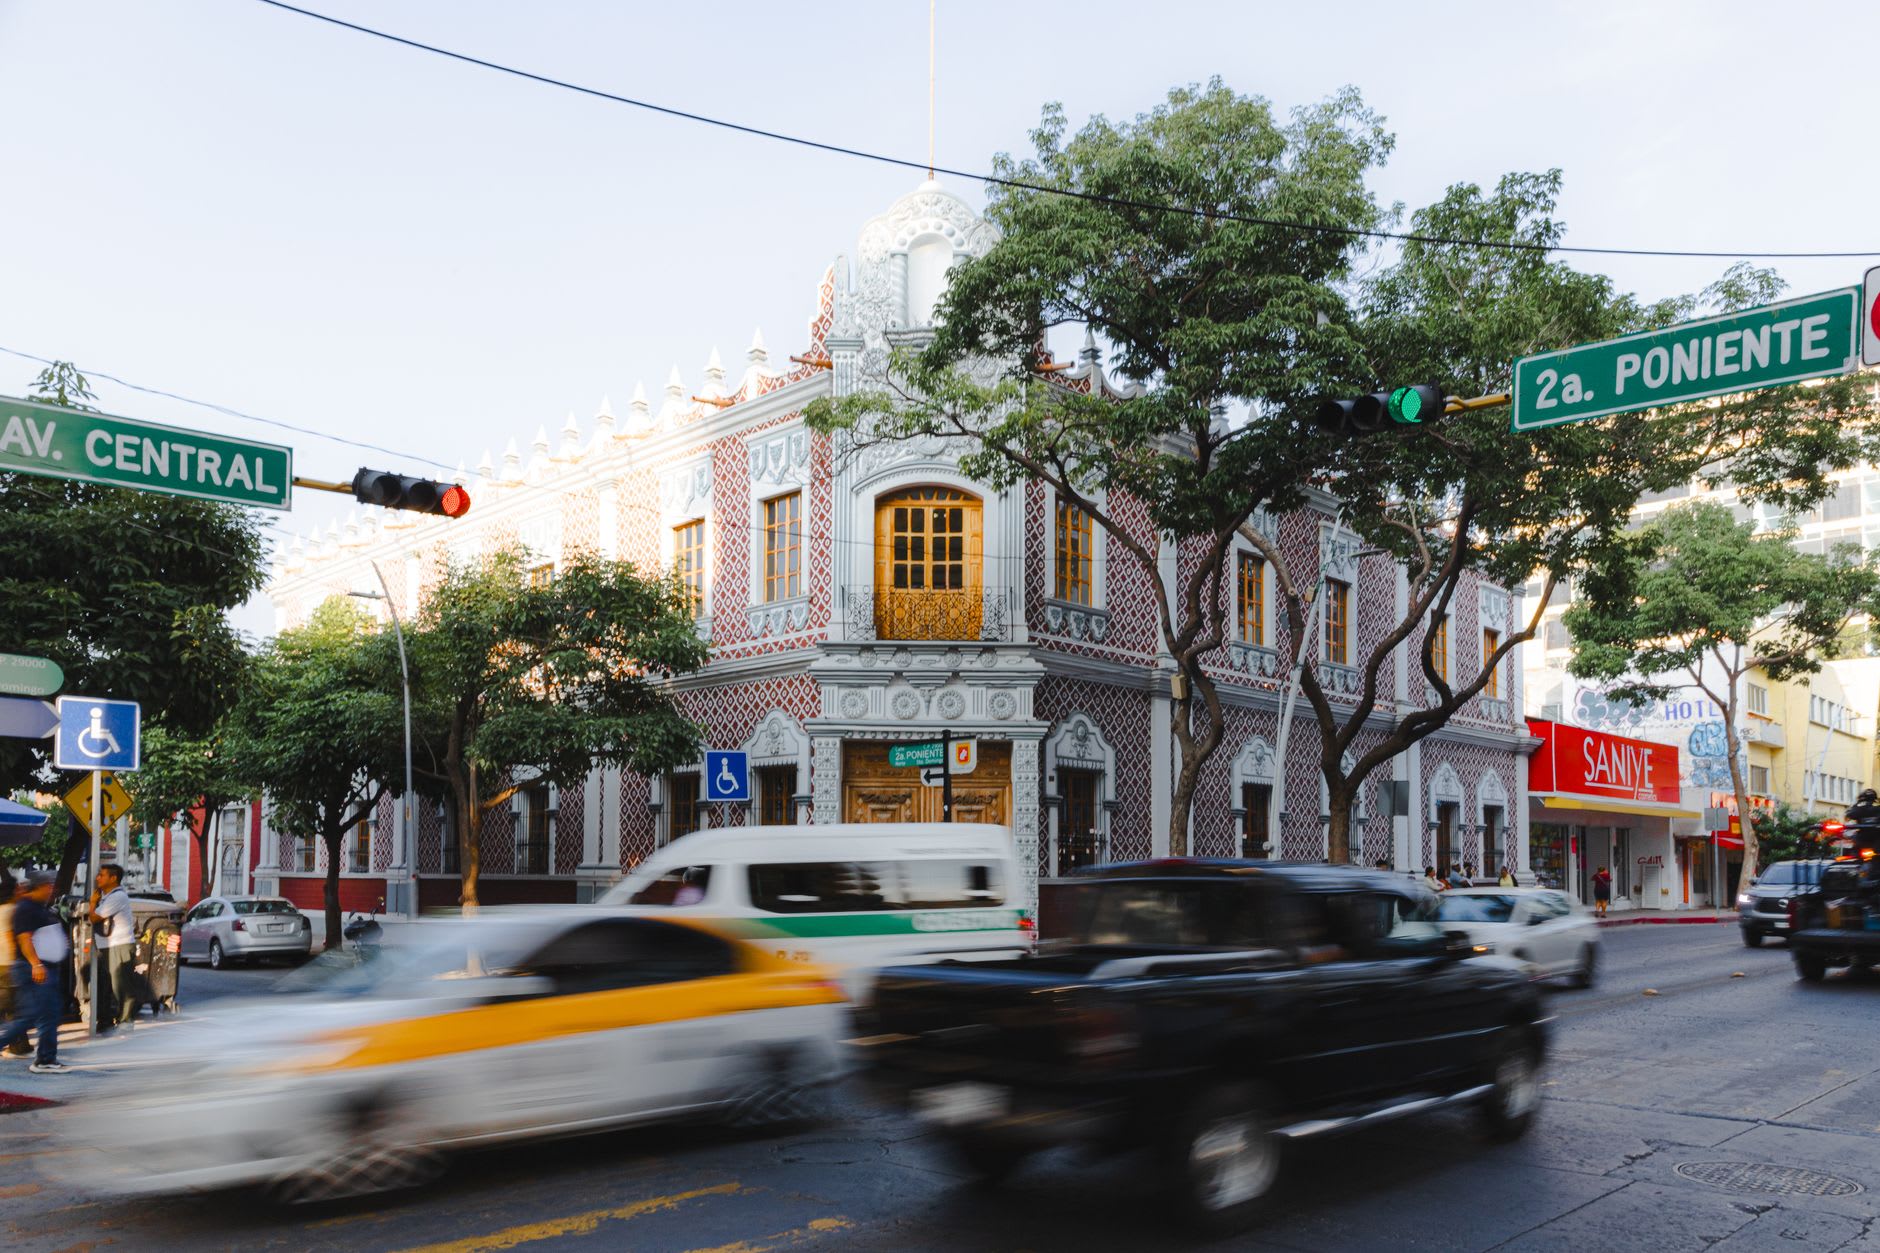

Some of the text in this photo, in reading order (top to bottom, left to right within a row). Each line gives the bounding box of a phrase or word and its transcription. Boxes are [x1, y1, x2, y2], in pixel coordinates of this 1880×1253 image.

[1535, 313, 1830, 410] 2a. PONIENTE
[1, 415, 278, 494] AV. CENTRAL
[11, 657, 47, 669] 29000
[0, 682, 45, 695] omingo
[895, 750, 944, 760] 2a. PONIENTE
[1583, 736, 1654, 800] SANIYE
